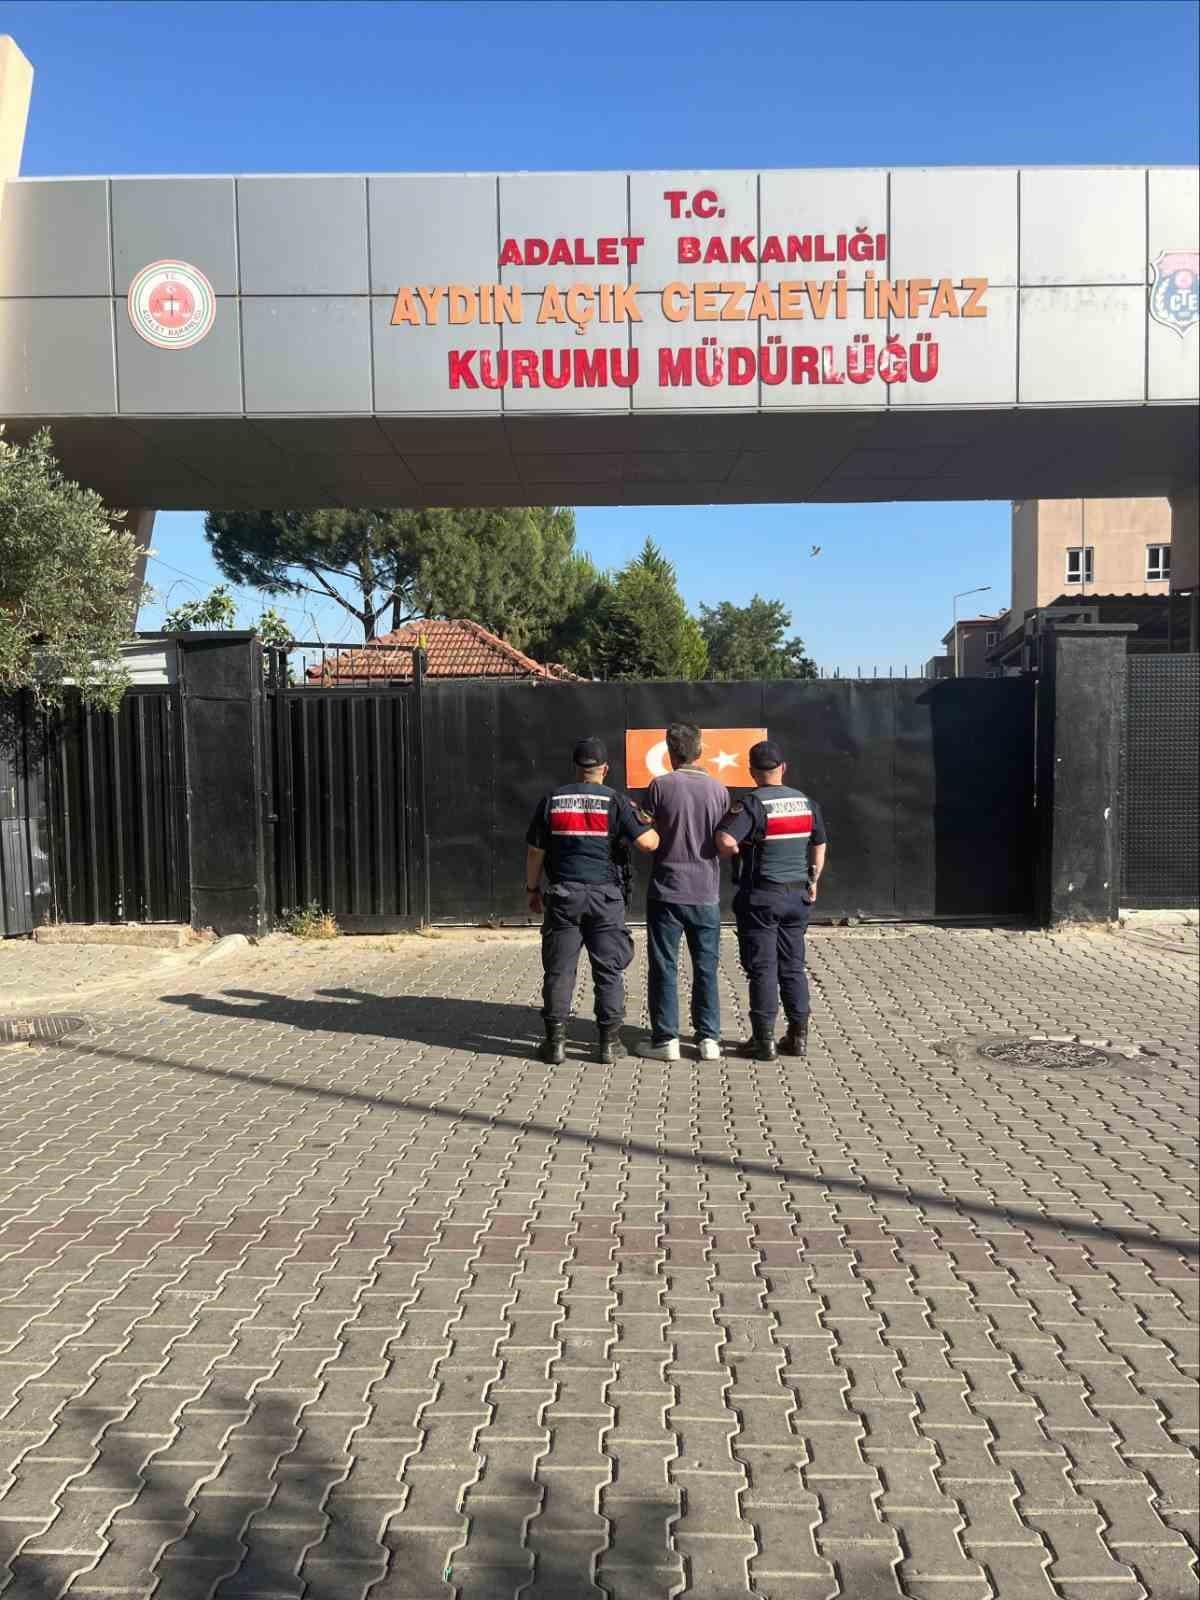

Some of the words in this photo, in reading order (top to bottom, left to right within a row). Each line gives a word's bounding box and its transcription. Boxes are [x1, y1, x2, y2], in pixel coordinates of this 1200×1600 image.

[664, 190, 725, 218] T.C.
[500, 237, 645, 266] ADALET
[677, 226, 887, 264] BAKANLIĞI
[390, 284, 523, 326] AYDIN
[536, 283, 643, 336] AÇIK
[661, 269, 849, 322] CEZAEVİ
[863, 270, 989, 319] İNFAZ
[448, 347, 640, 389] KURUMU
[658, 332, 939, 387] MÜDÜRLÜĞÜ
